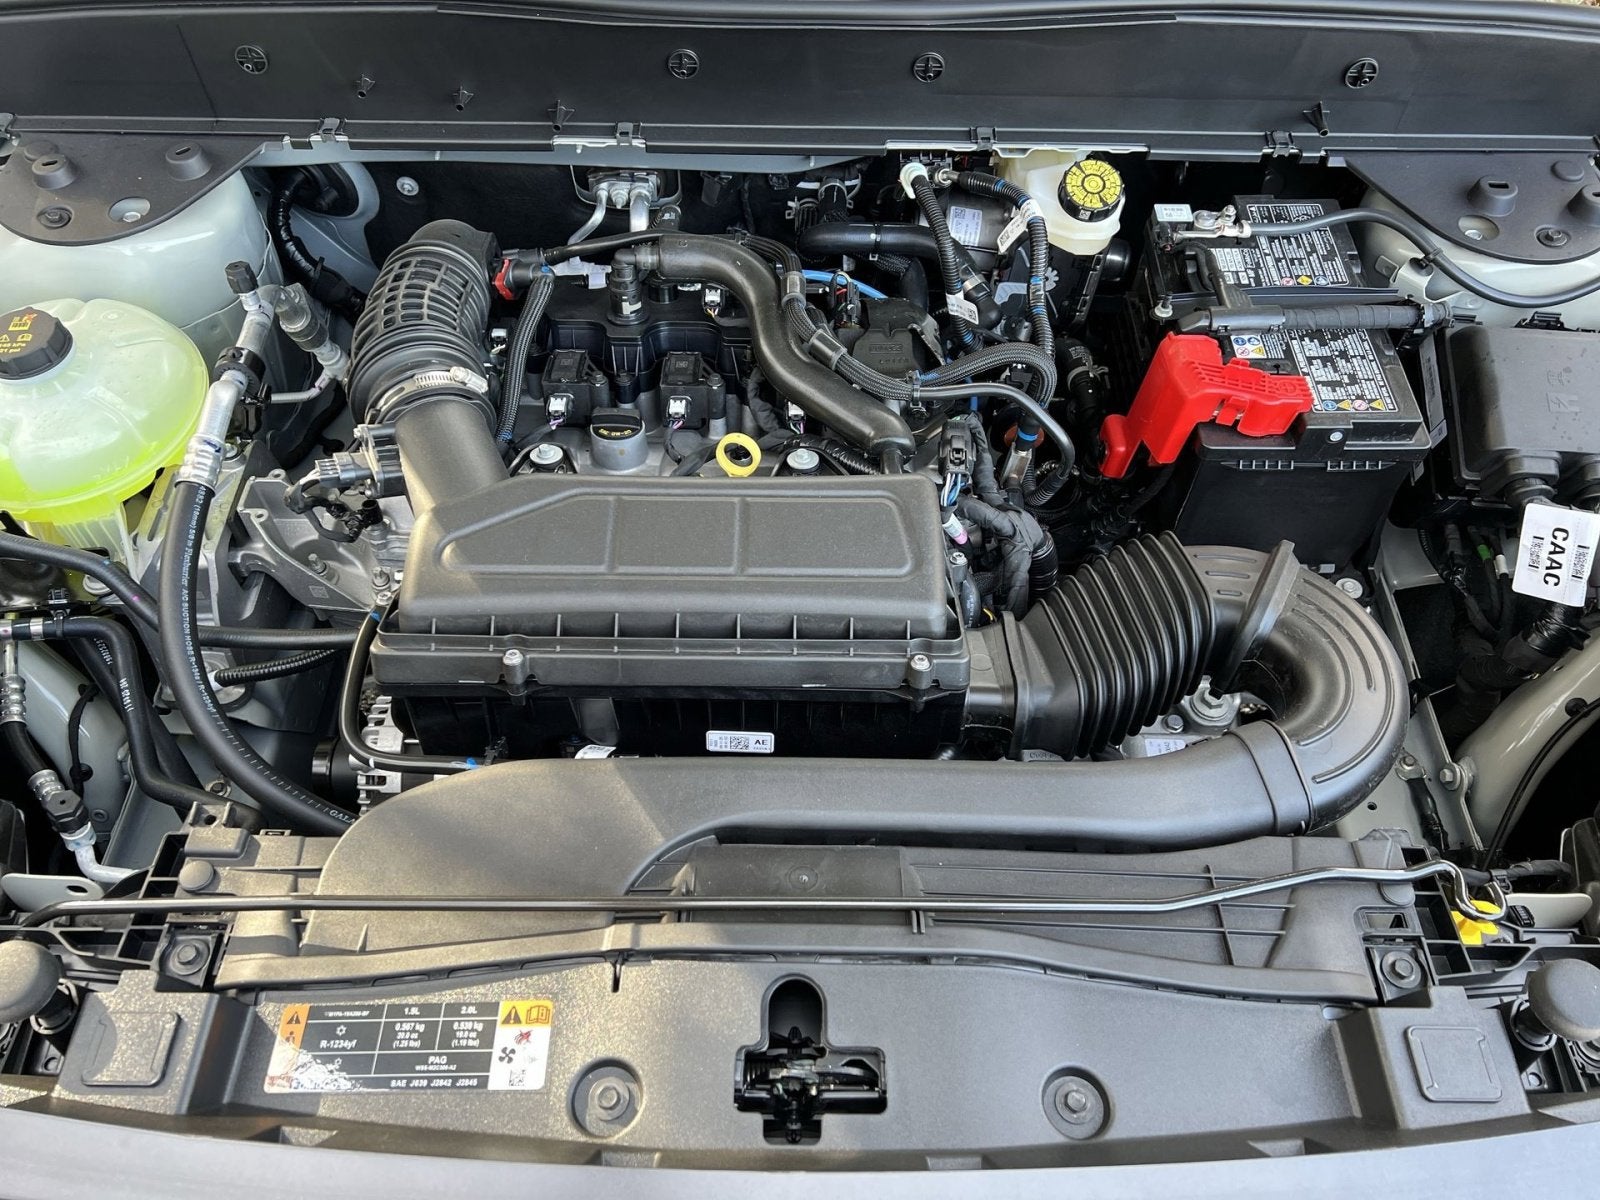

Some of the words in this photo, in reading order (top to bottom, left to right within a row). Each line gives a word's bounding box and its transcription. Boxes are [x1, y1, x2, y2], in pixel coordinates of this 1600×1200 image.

[1543, 527, 1570, 587] CAAC
[181, 588, 189, 601] A/C
[182, 602, 191, 634] SUCTION
[185, 635, 195, 656] HOSE
[404, 1006, 420, 1015] 1.5L
[460, 1005, 478, 1015] 2.0L
[415, 1022, 426, 1033] kg
[473, 1021, 484, 1032] kg
[320, 1039, 358, 1050] R-1234yf
[428, 1055, 448, 1064] PAG
[389, 1079, 407, 1088] SAE
